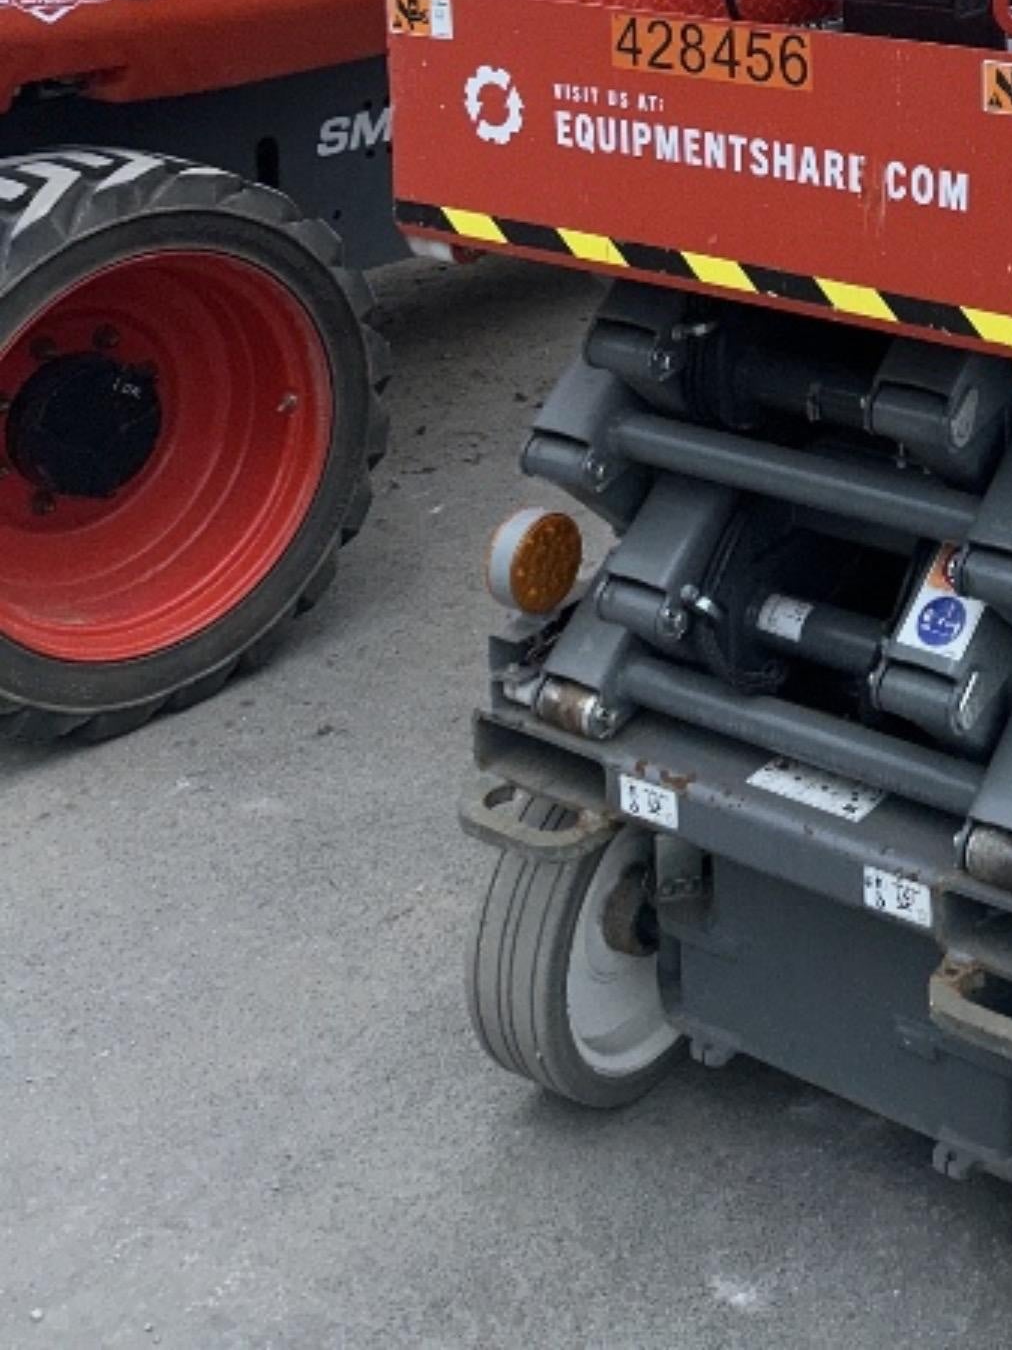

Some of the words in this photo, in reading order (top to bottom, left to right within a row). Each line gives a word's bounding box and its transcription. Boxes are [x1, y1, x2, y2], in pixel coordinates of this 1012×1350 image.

[616, 16, 809, 86] 428456
[553, 82, 599, 105] VISIT
[607, 88, 629, 109] US
[637, 93, 664, 112] AT:
